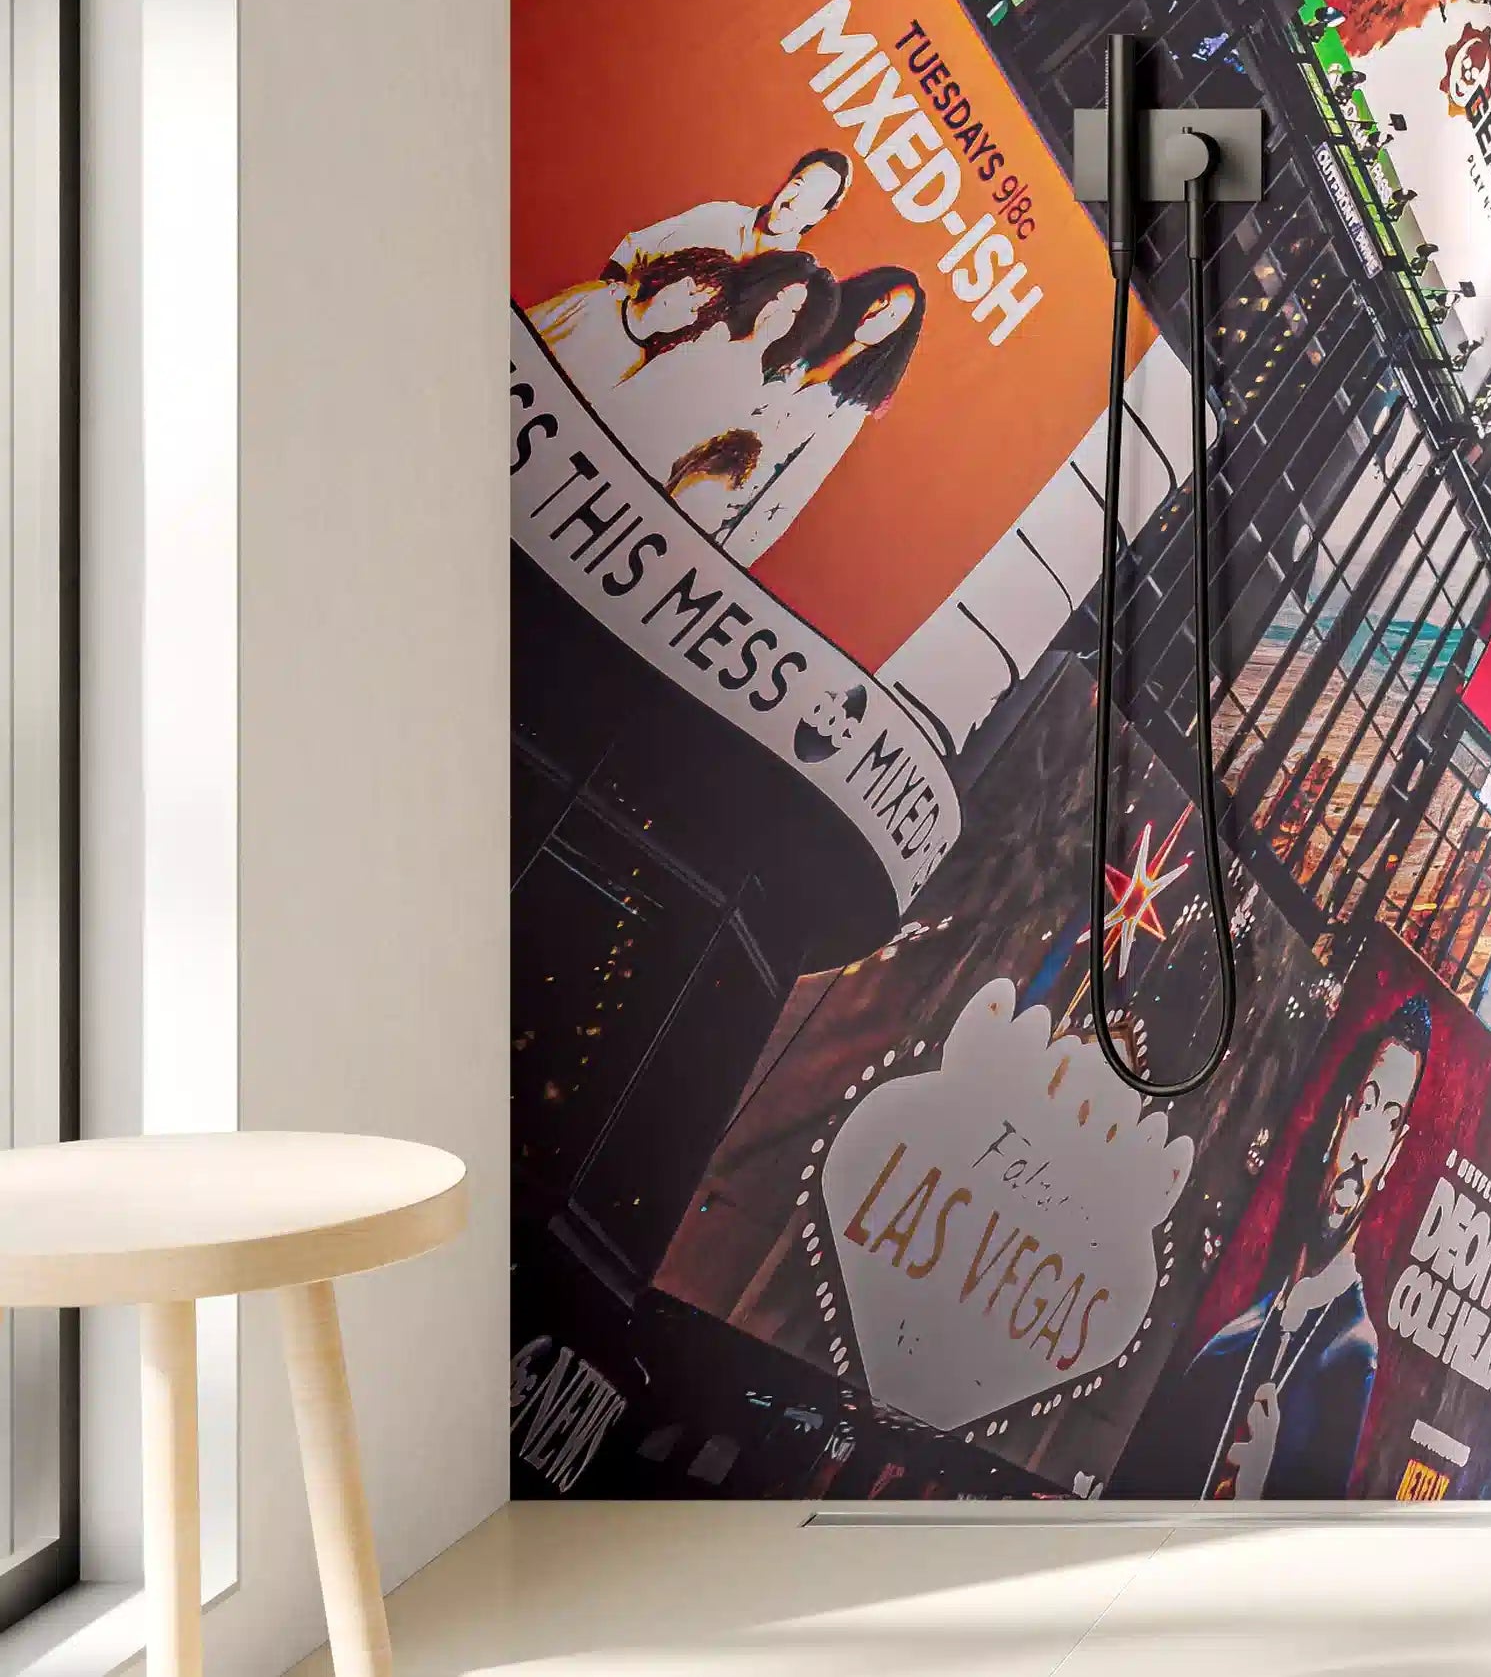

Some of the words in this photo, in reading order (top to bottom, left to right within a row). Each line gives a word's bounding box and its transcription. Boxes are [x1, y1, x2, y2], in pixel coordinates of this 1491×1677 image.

[892, 20, 1004, 182] TUESDAYS
[529, 450, 667, 597] THIS
[641, 567, 808, 712] MESS
